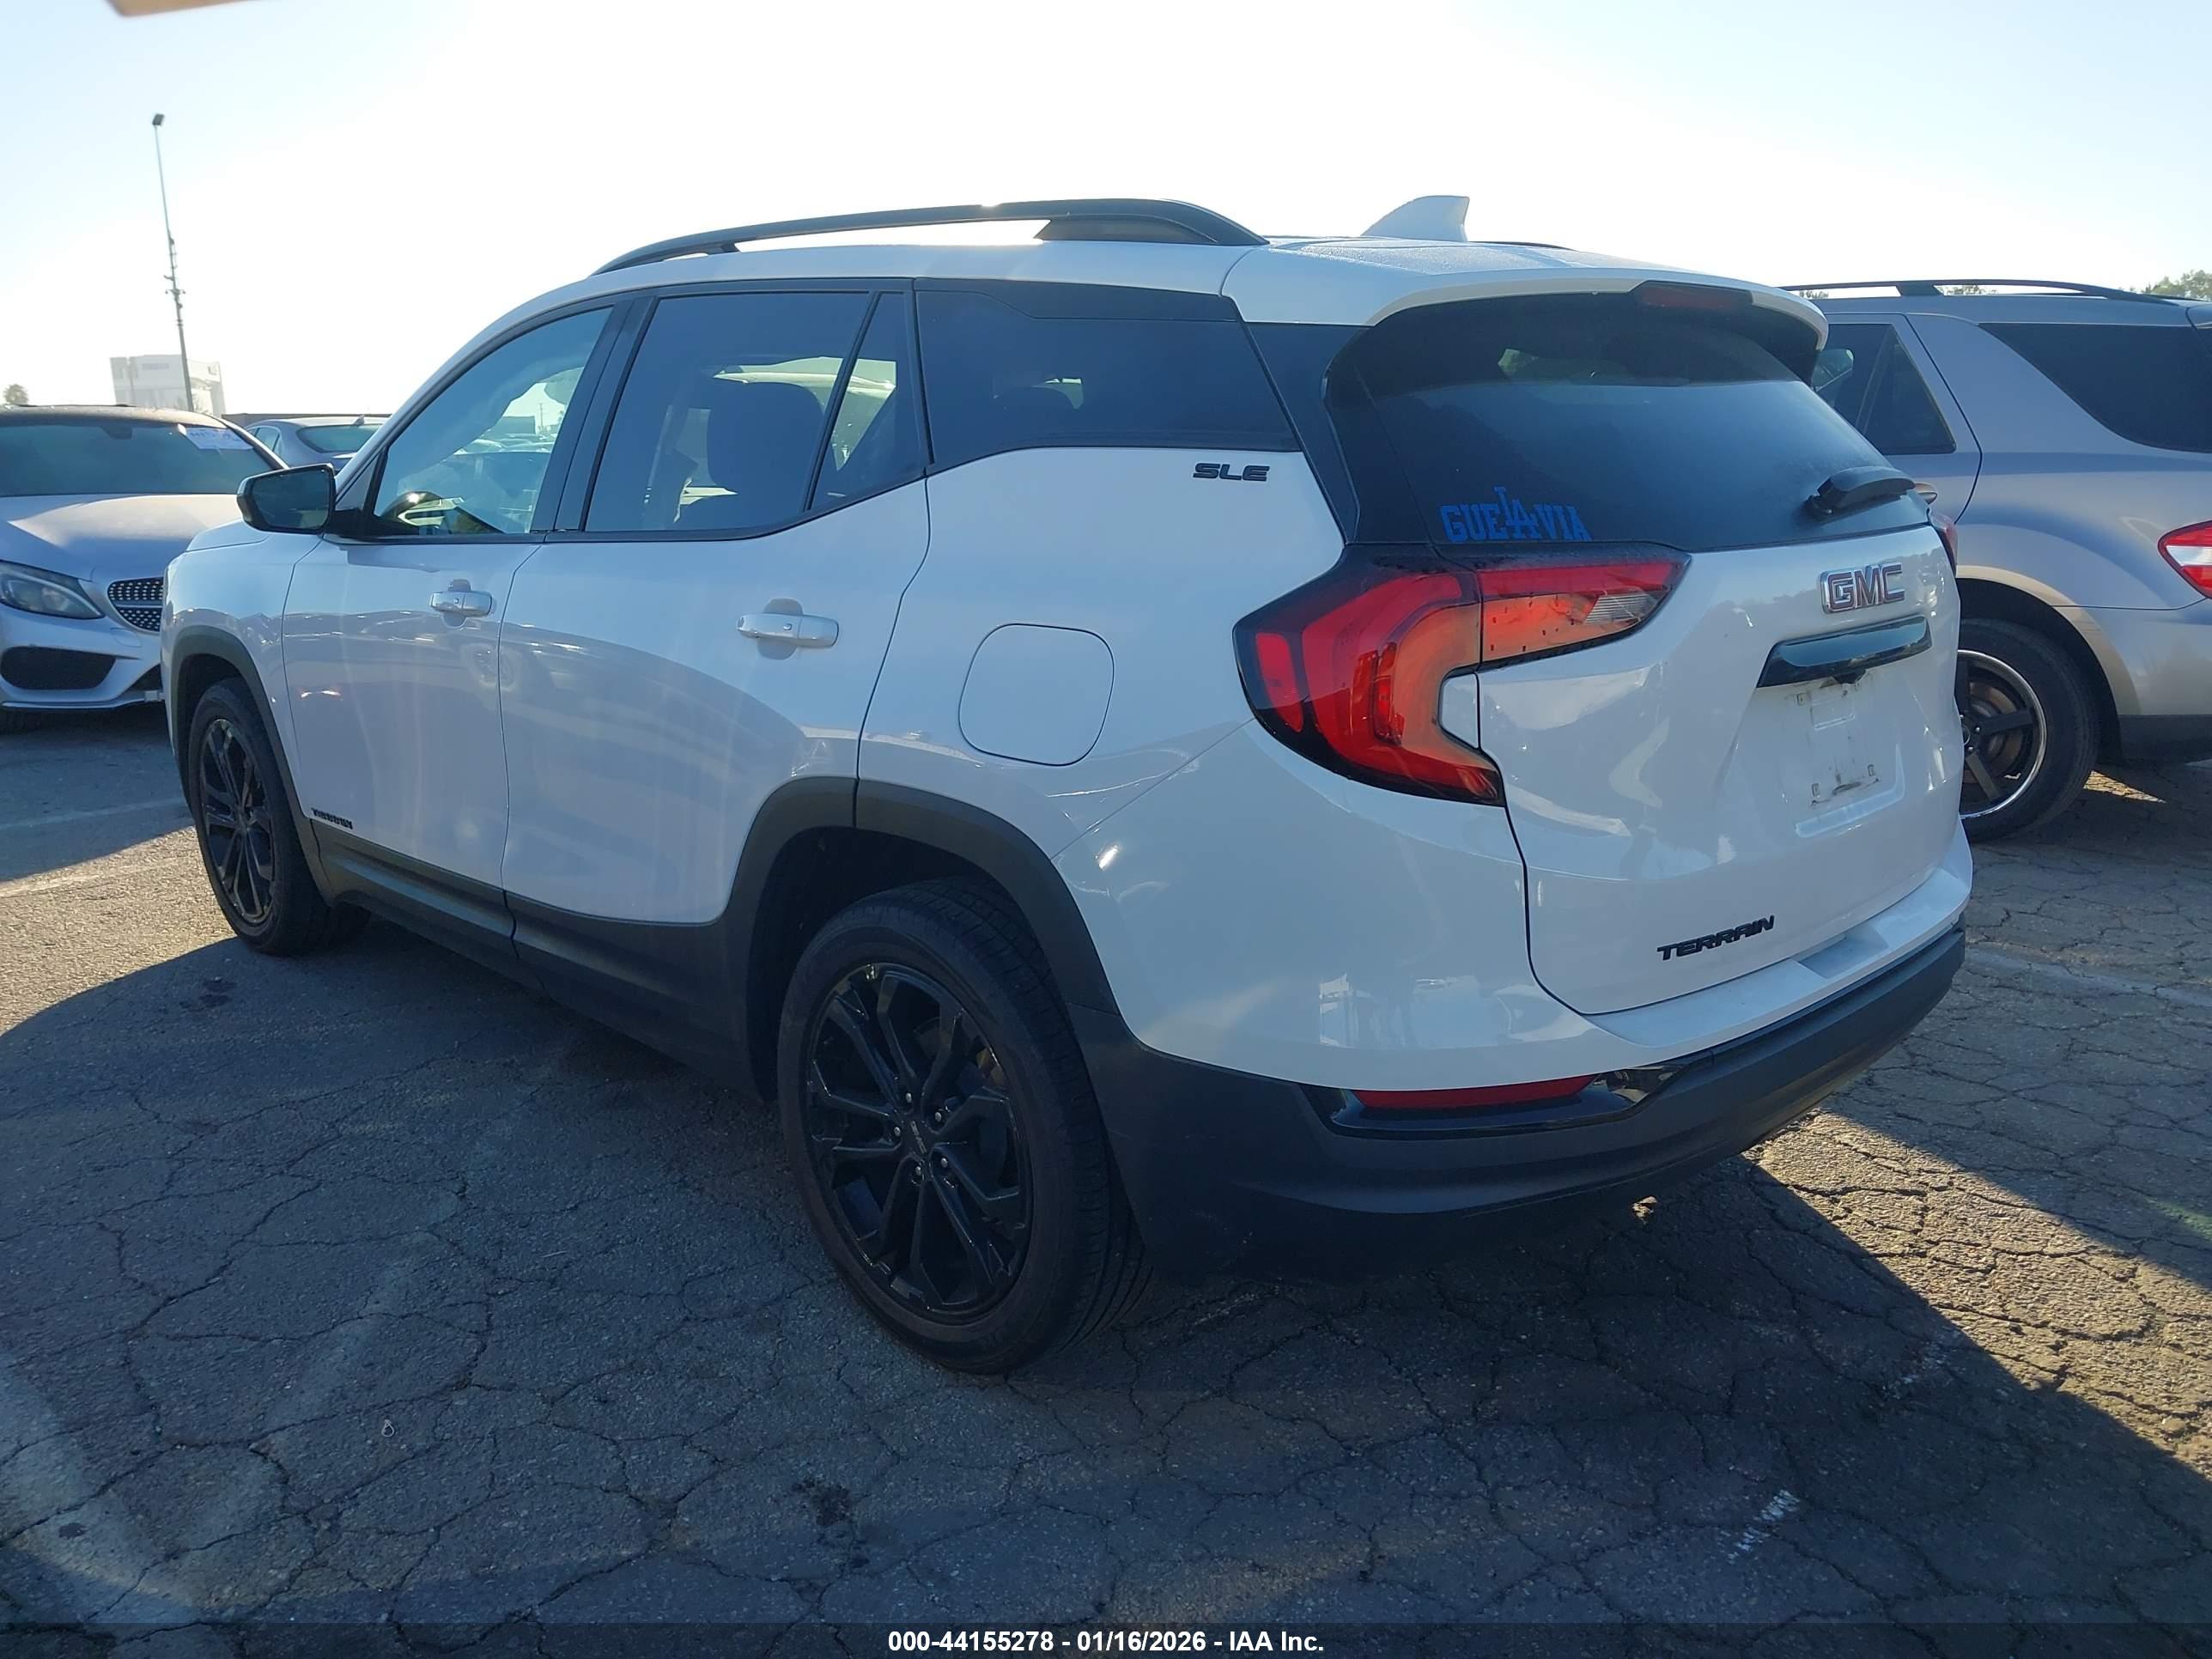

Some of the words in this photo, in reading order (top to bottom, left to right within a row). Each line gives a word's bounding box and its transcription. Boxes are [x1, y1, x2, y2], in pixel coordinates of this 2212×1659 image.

[1192, 462, 1270, 482] SLE
[1826, 562, 1905, 612] GMC
[1656, 915, 1775, 961] TERRAIN
